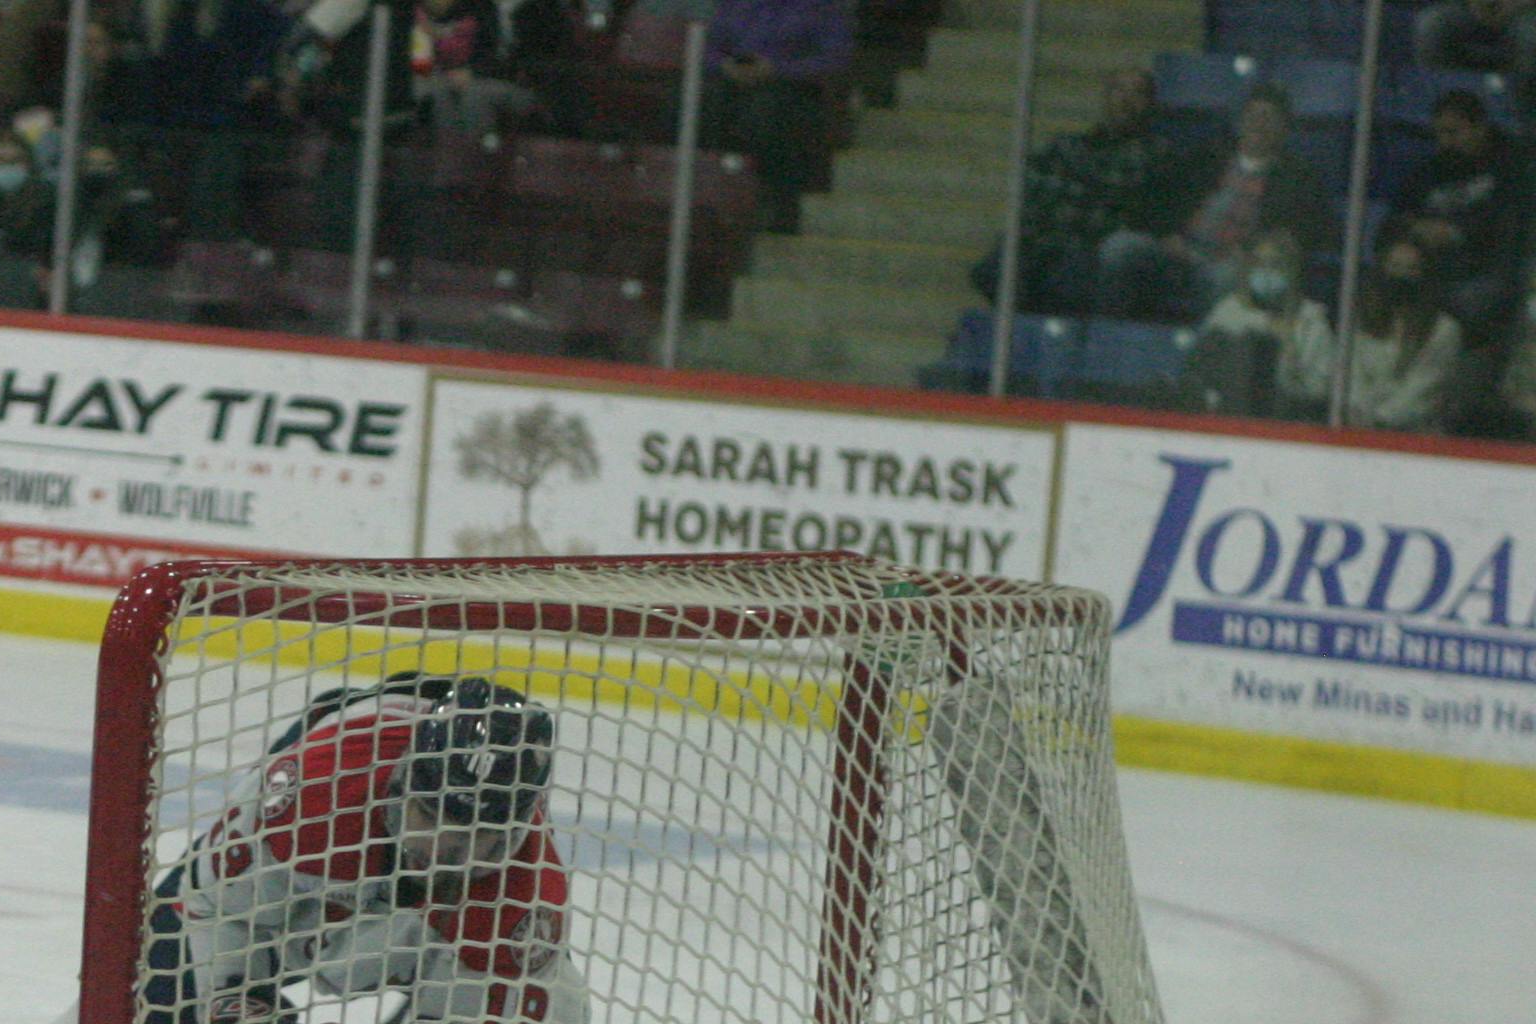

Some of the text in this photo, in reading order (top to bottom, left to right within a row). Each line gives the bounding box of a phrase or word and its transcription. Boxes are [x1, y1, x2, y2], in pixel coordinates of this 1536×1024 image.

[204, 390, 407, 458] TIRE
[196, 458, 386, 487] LIMITED
[640, 430, 1019, 508] SARAH TRASK
[118, 479, 255, 527] WOLFVILLE
[635, 496, 1015, 577] HOMEOPATHY
[1111, 452, 1536, 637] JORDA
[1222, 612, 1321, 653] HOME
[1231, 668, 1304, 705] New
[1316, 678, 1410, 718] Minas
[1421, 693, 1482, 728] and
